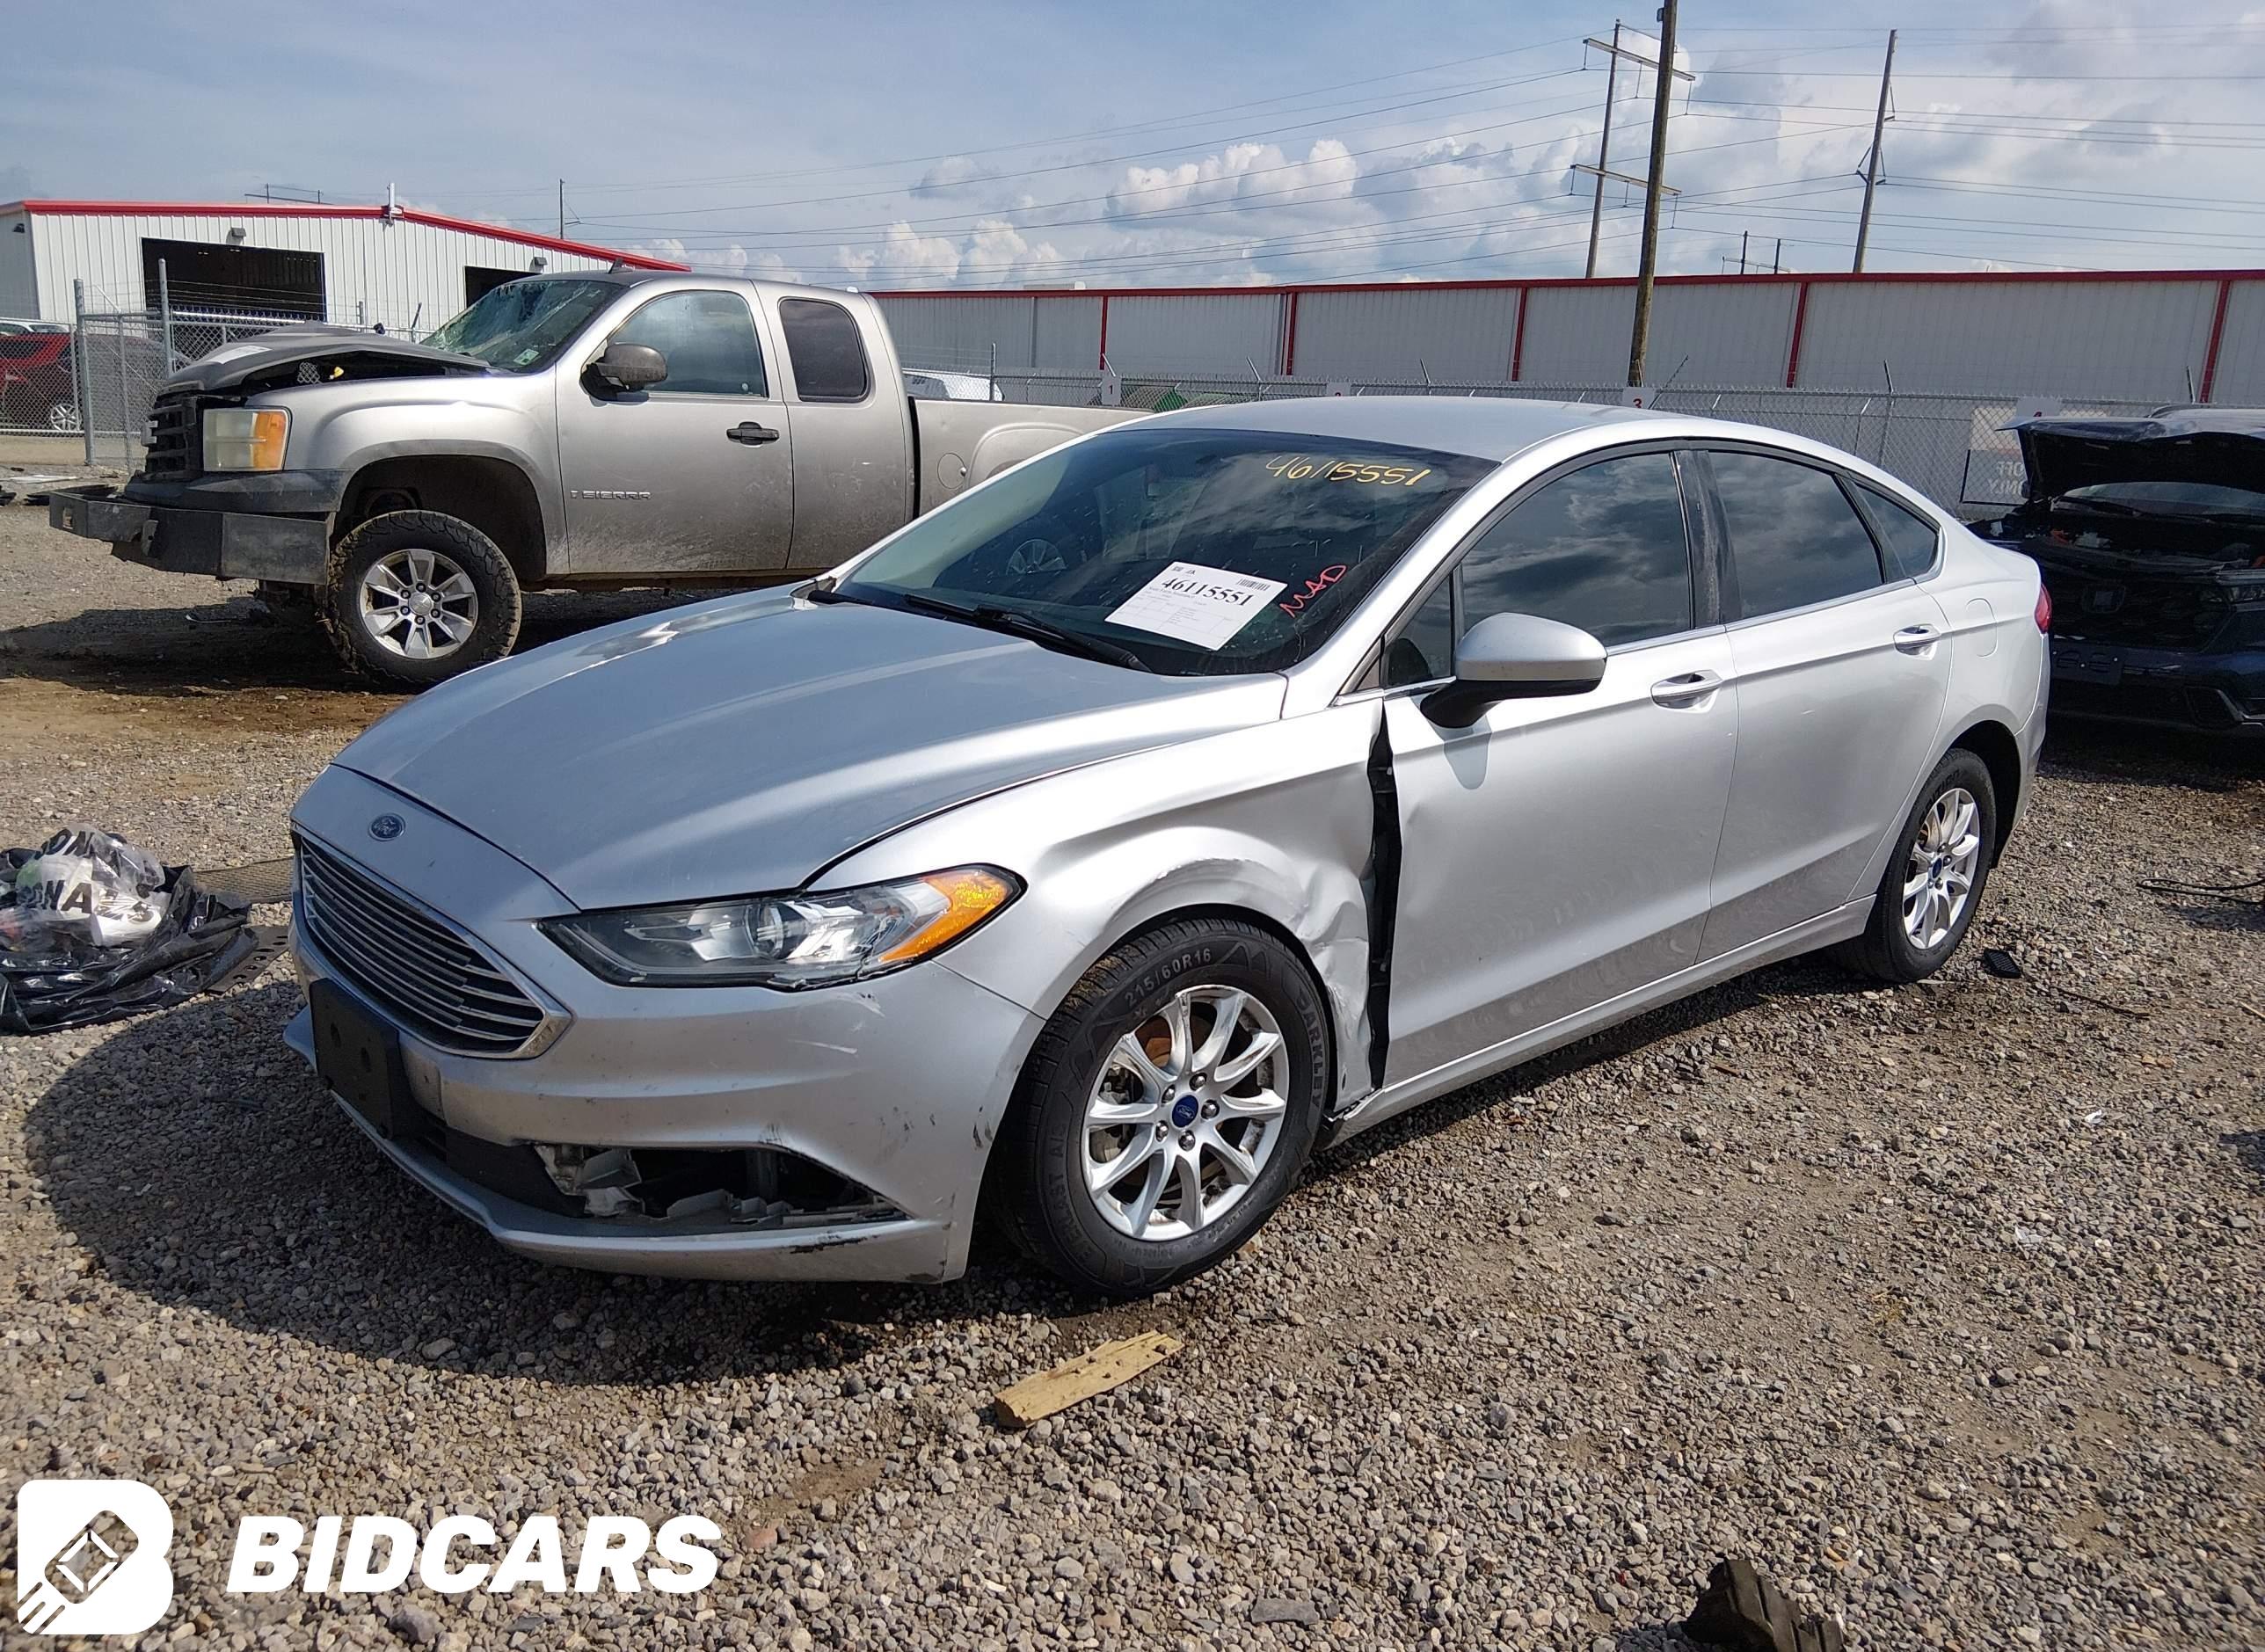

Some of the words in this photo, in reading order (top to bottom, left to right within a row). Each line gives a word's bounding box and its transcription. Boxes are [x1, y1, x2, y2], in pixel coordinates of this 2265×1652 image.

[1265, 455, 1431, 486] 46115551
[1162, 577, 1256, 607] 46115551
[1125, 947, 1212, 1008] 215/60R16
